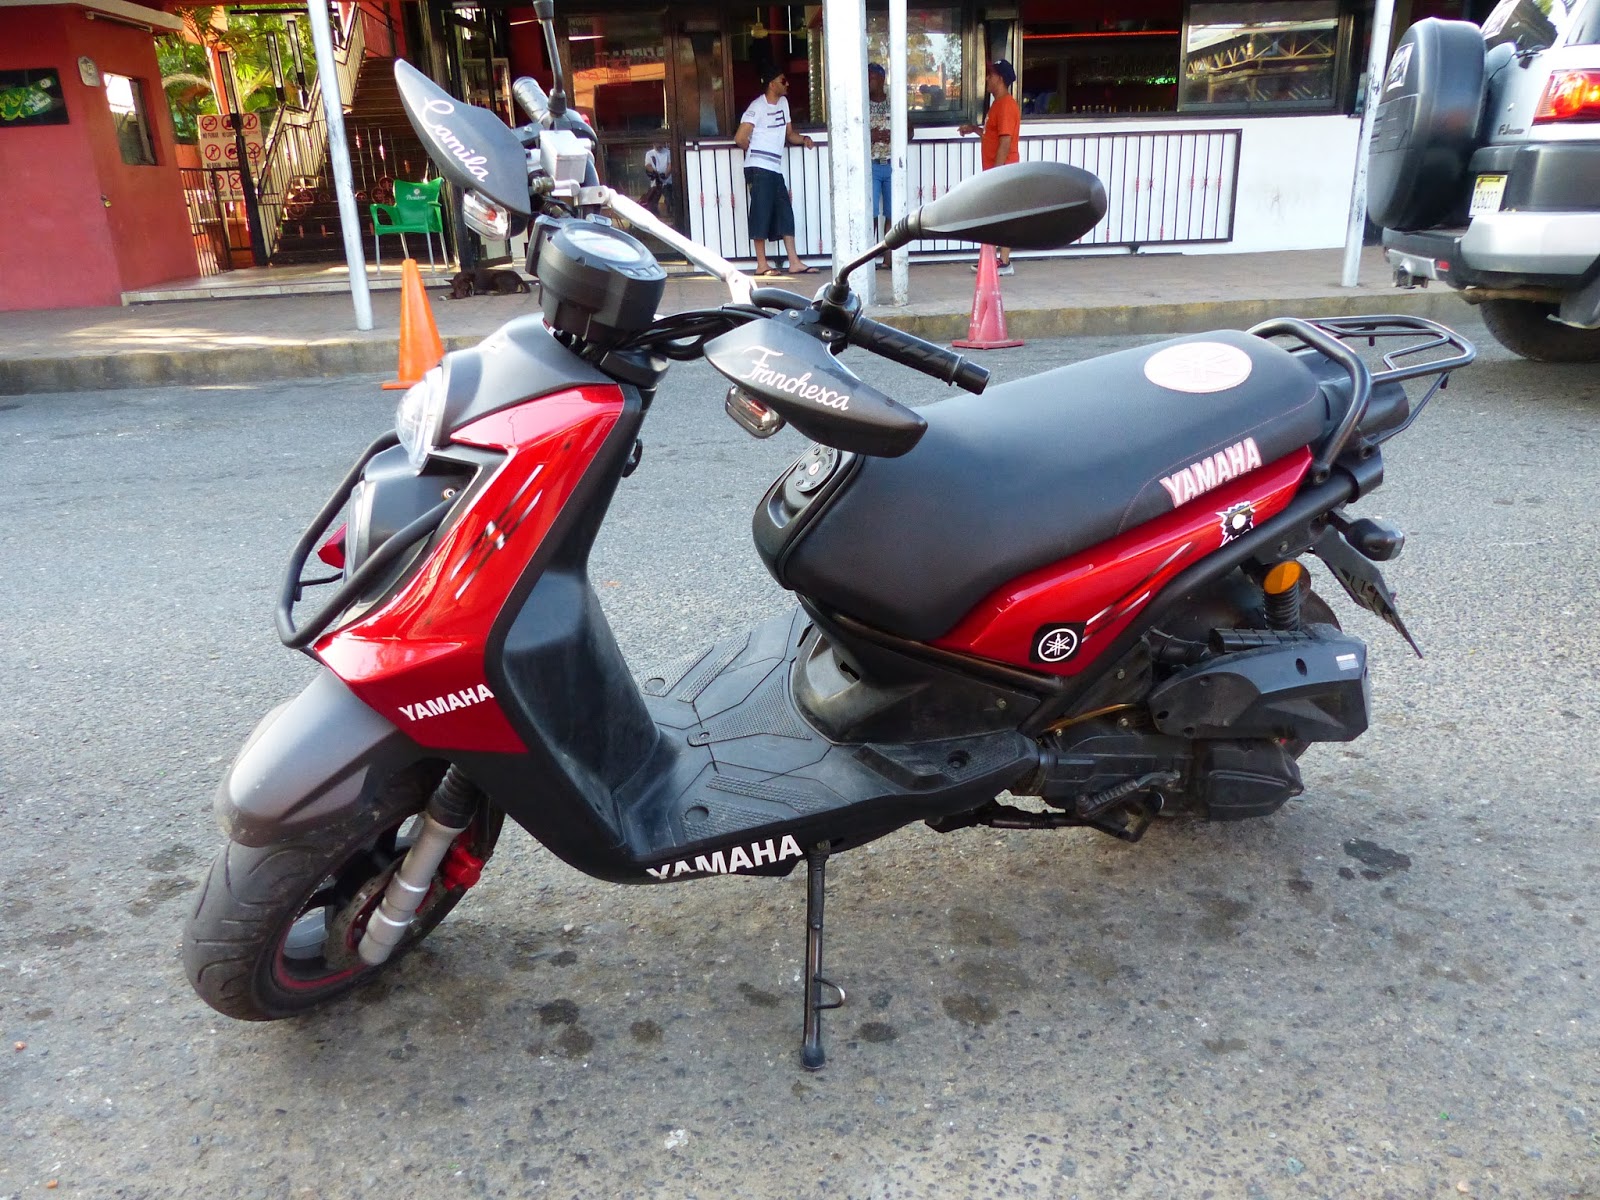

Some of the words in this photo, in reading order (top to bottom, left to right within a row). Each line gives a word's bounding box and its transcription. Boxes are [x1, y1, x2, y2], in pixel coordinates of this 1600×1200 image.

[422, 97, 489, 183] Camila
[742, 345, 850, 411] Franchesca
[1158, 436, 1263, 509] YAMAHA
[397, 683, 495, 722] YAMAHA
[646, 834, 804, 880] YAMAHA
